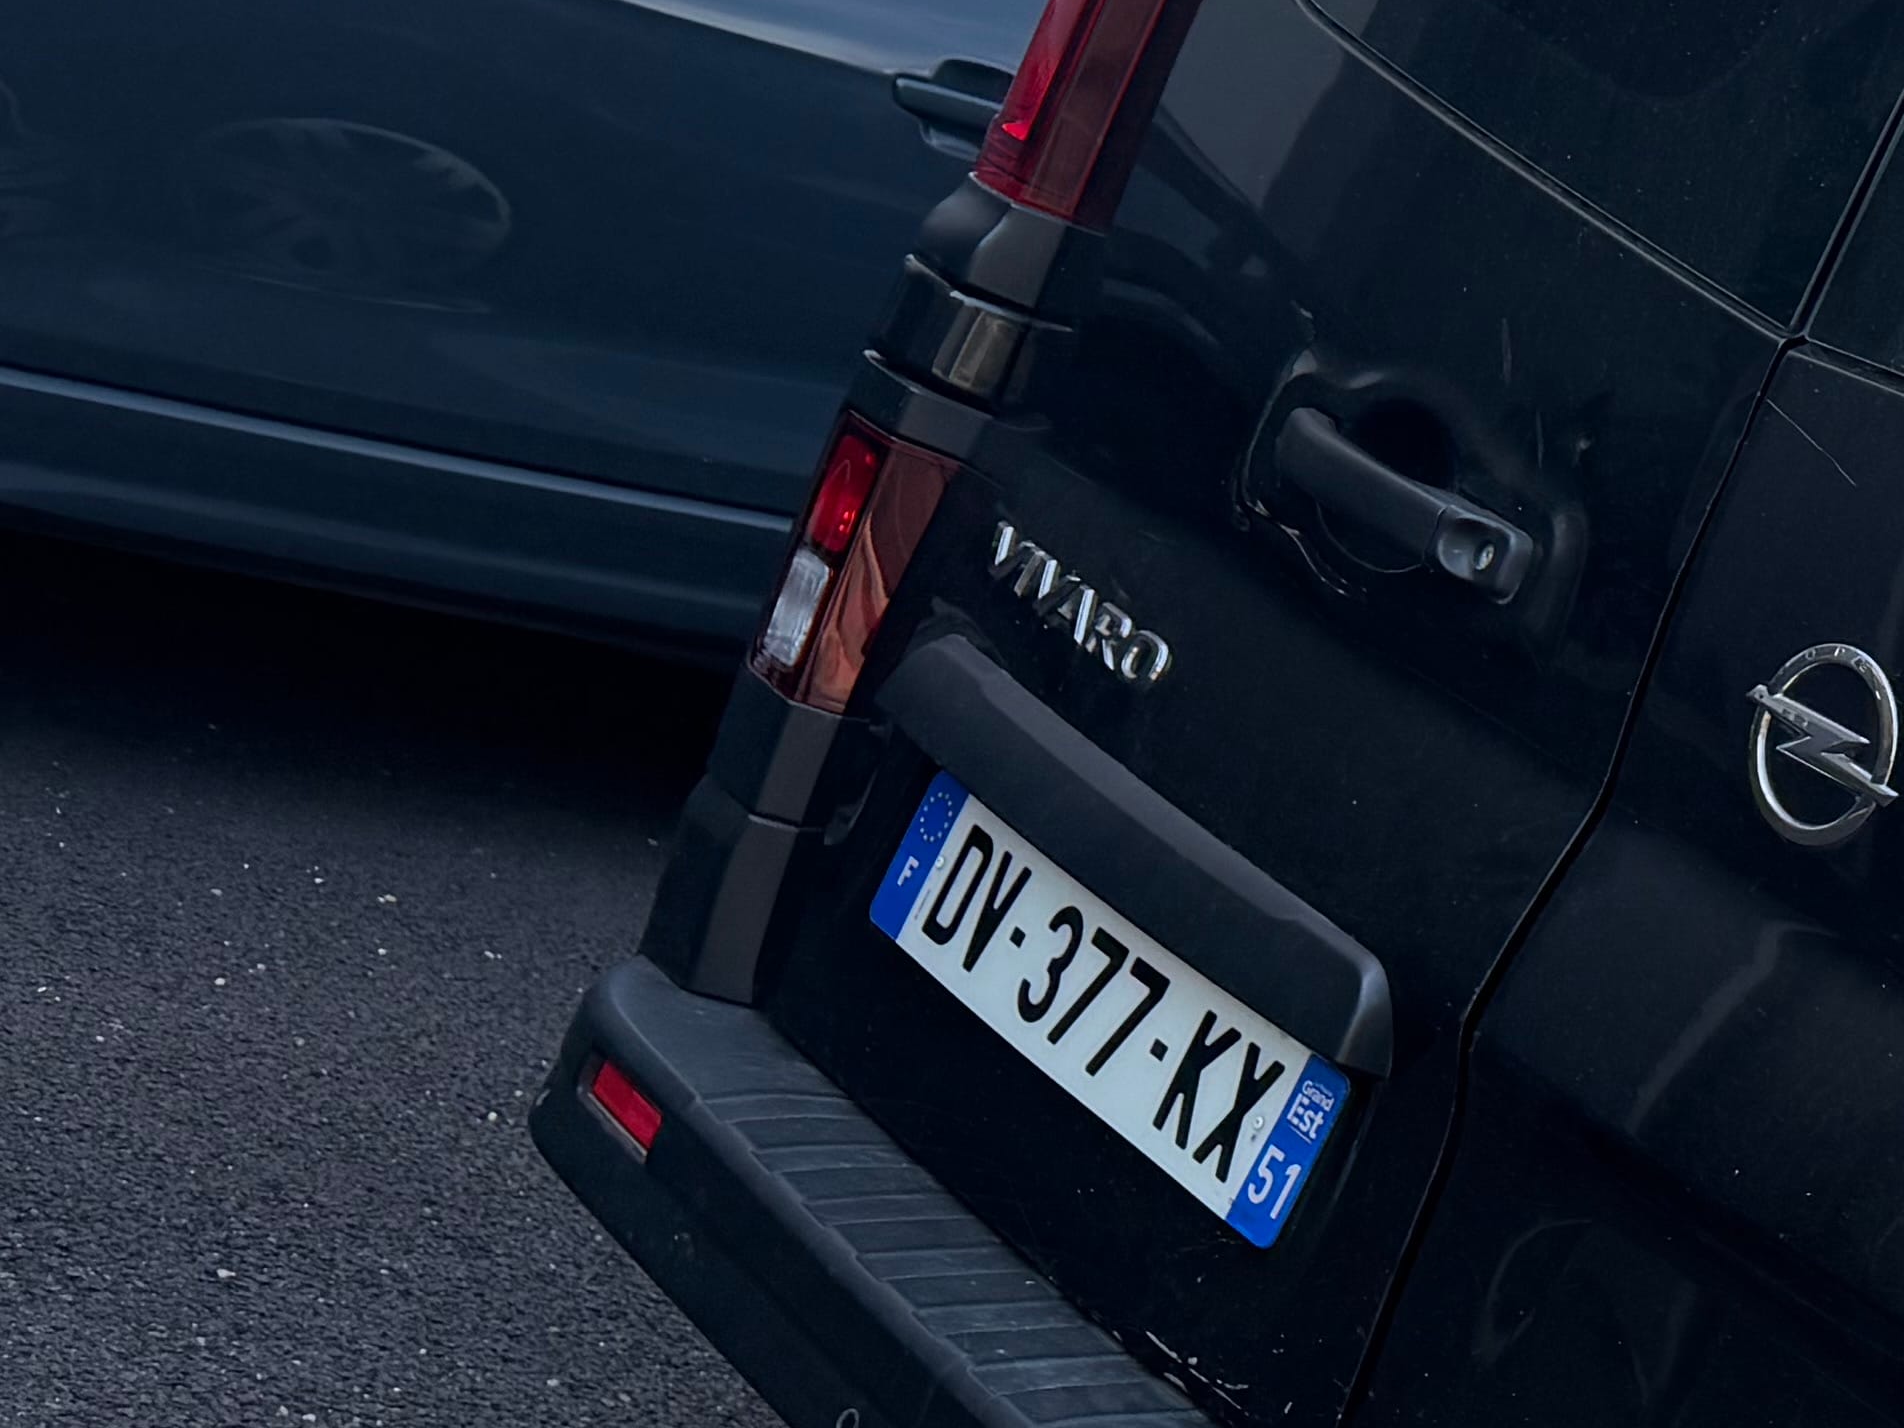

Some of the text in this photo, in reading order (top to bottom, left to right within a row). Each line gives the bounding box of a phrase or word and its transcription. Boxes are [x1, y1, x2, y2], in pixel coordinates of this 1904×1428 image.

[988, 521, 1174, 682] VIVARO
[897, 855, 920, 886] F
[921, 823, 1287, 1184] DV-377-KX
[1288, 1093, 1324, 1139] Est
[1302, 1079, 1335, 1112] Grand
[1248, 1144, 1301, 1219] 51
